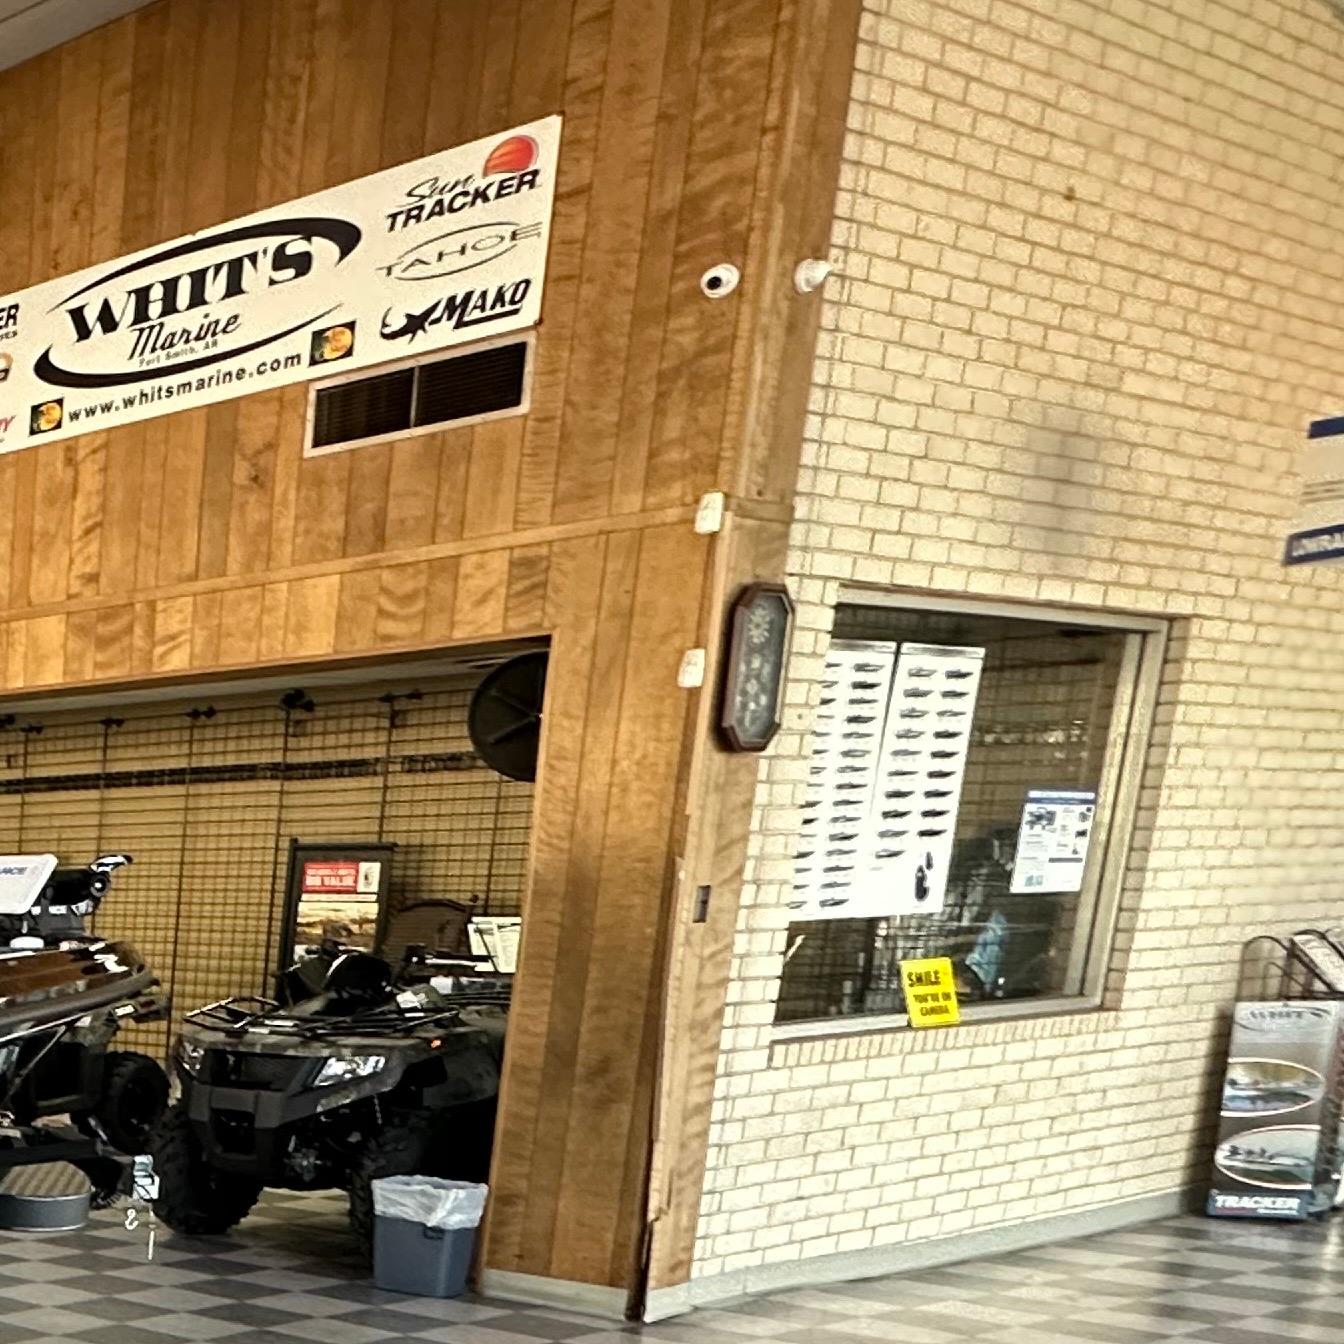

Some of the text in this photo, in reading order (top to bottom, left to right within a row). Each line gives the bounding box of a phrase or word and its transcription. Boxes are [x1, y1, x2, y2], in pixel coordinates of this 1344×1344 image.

[385, 168, 541, 232] TRACKER
[396, 174, 476, 207] Sun
[376, 221, 543, 277] TAHOE
[65, 234, 313, 343] WHIT'S
[429, 278, 532, 330] MAKO
[127, 312, 242, 361] Marine
[67, 352, 303, 424] www.whitsmarine.com
